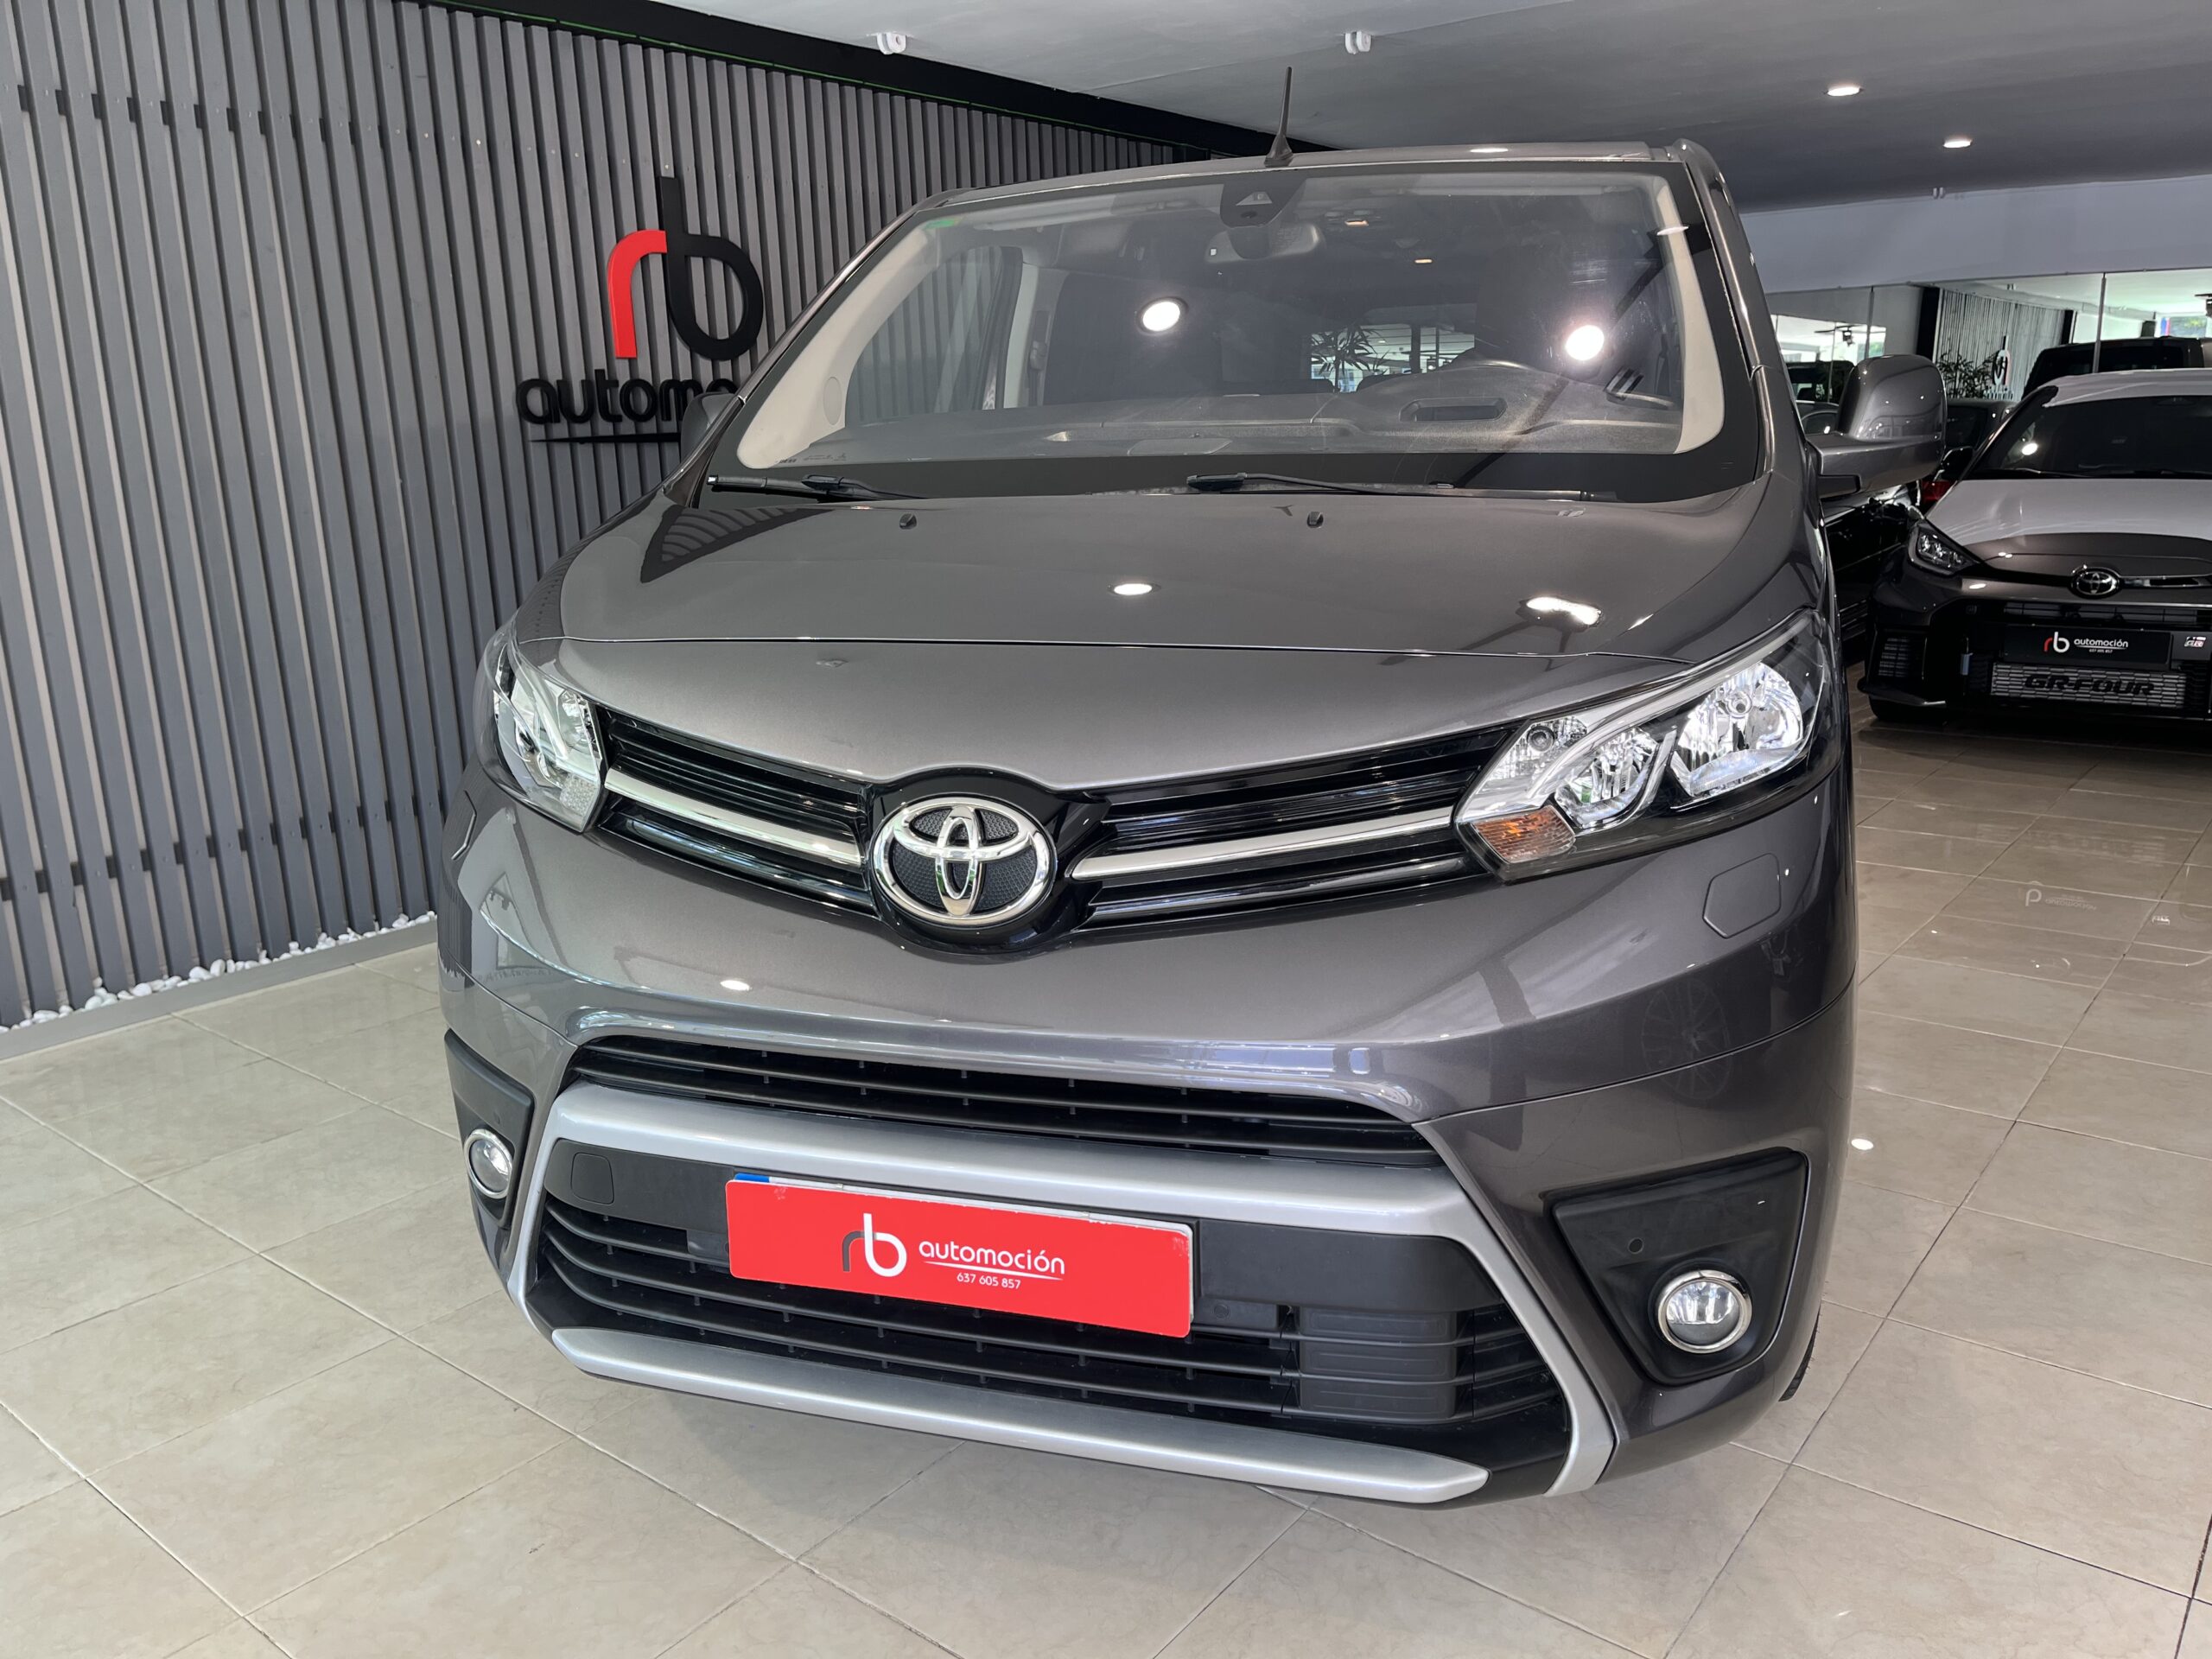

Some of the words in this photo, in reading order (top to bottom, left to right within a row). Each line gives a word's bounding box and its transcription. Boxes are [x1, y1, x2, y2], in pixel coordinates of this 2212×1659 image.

[516, 368, 738, 424] autom
[2074, 638, 2129, 648] automoción
[918, 1240, 1066, 1275] automoción
[956, 1272, 976, 1284] 637
[978, 1275, 999, 1287] 605
[1001, 1279, 1021, 1290] 857
